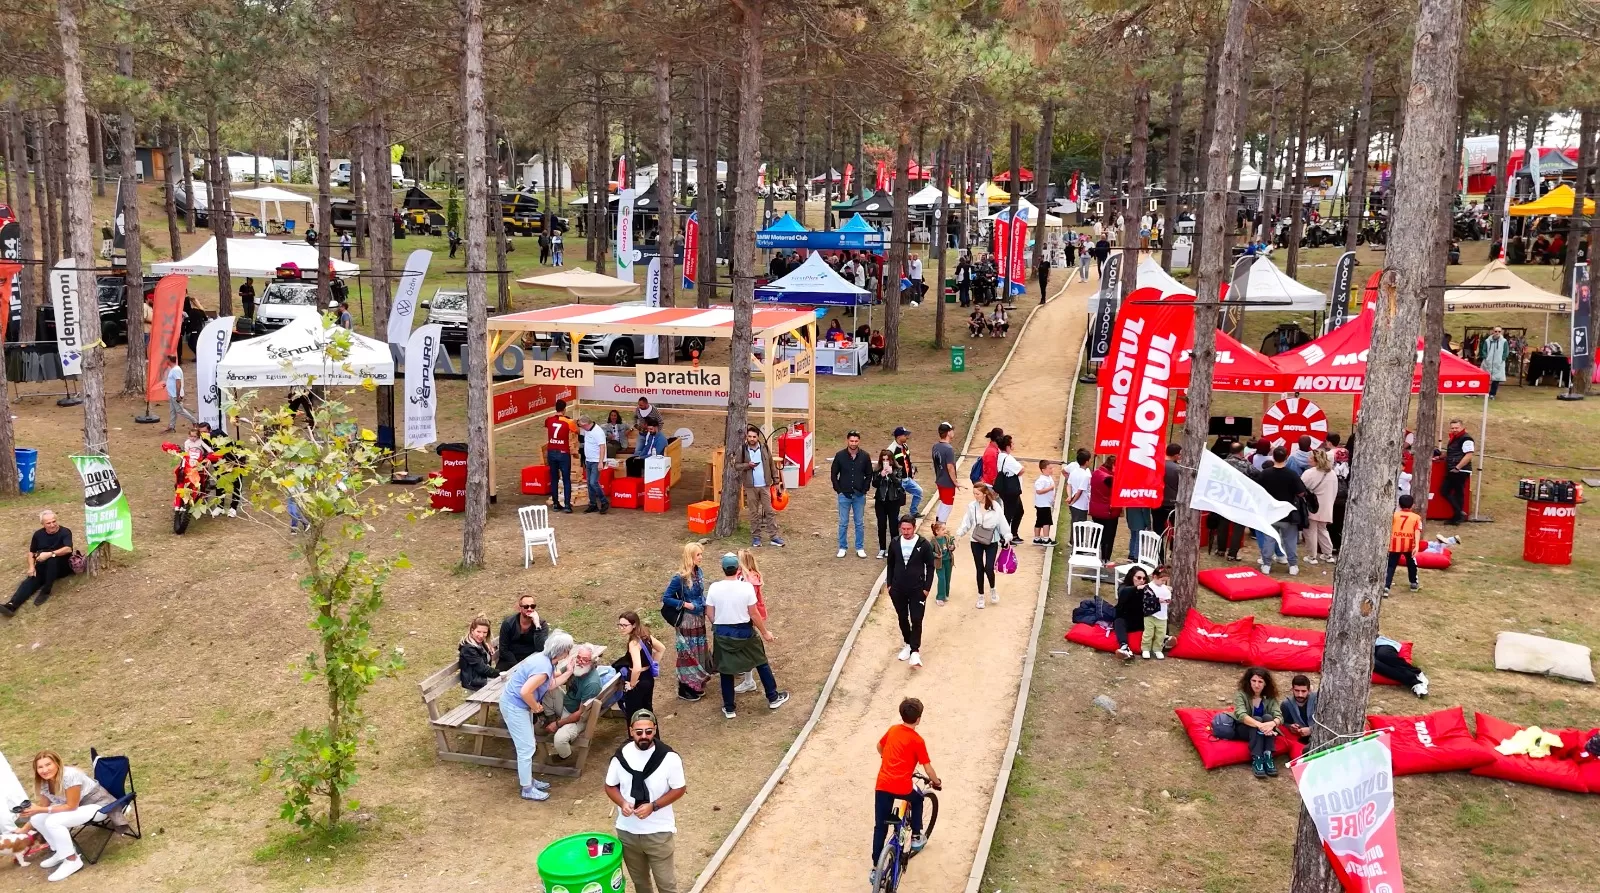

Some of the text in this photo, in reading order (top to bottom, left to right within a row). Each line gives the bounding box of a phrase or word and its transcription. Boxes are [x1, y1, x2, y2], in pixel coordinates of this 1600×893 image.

[1108, 257, 1119, 289] more
[1340, 257, 1351, 290] more
[1105, 292, 1114, 300] &
[1338, 292, 1347, 303] &
[60, 273, 76, 348] demmon
[534, 364, 584, 381] Payten
[645, 369, 721, 387] paratika
[1106, 316, 1146, 424] MOTUL
[1293, 375, 1364, 391] MOTUL
[1128, 332, 1177, 471] MOTUL
[497, 404, 518, 421] paratika
[552, 422, 563, 439] 7
[1282, 424, 1308, 432] MOTUL
[443, 459, 467, 467] Payten
[614, 491, 632, 499] Payten
[1120, 488, 1158, 499] MOTUL
[1400, 515, 1409, 531] 7
[1225, 571, 1258, 579] MOTUL
